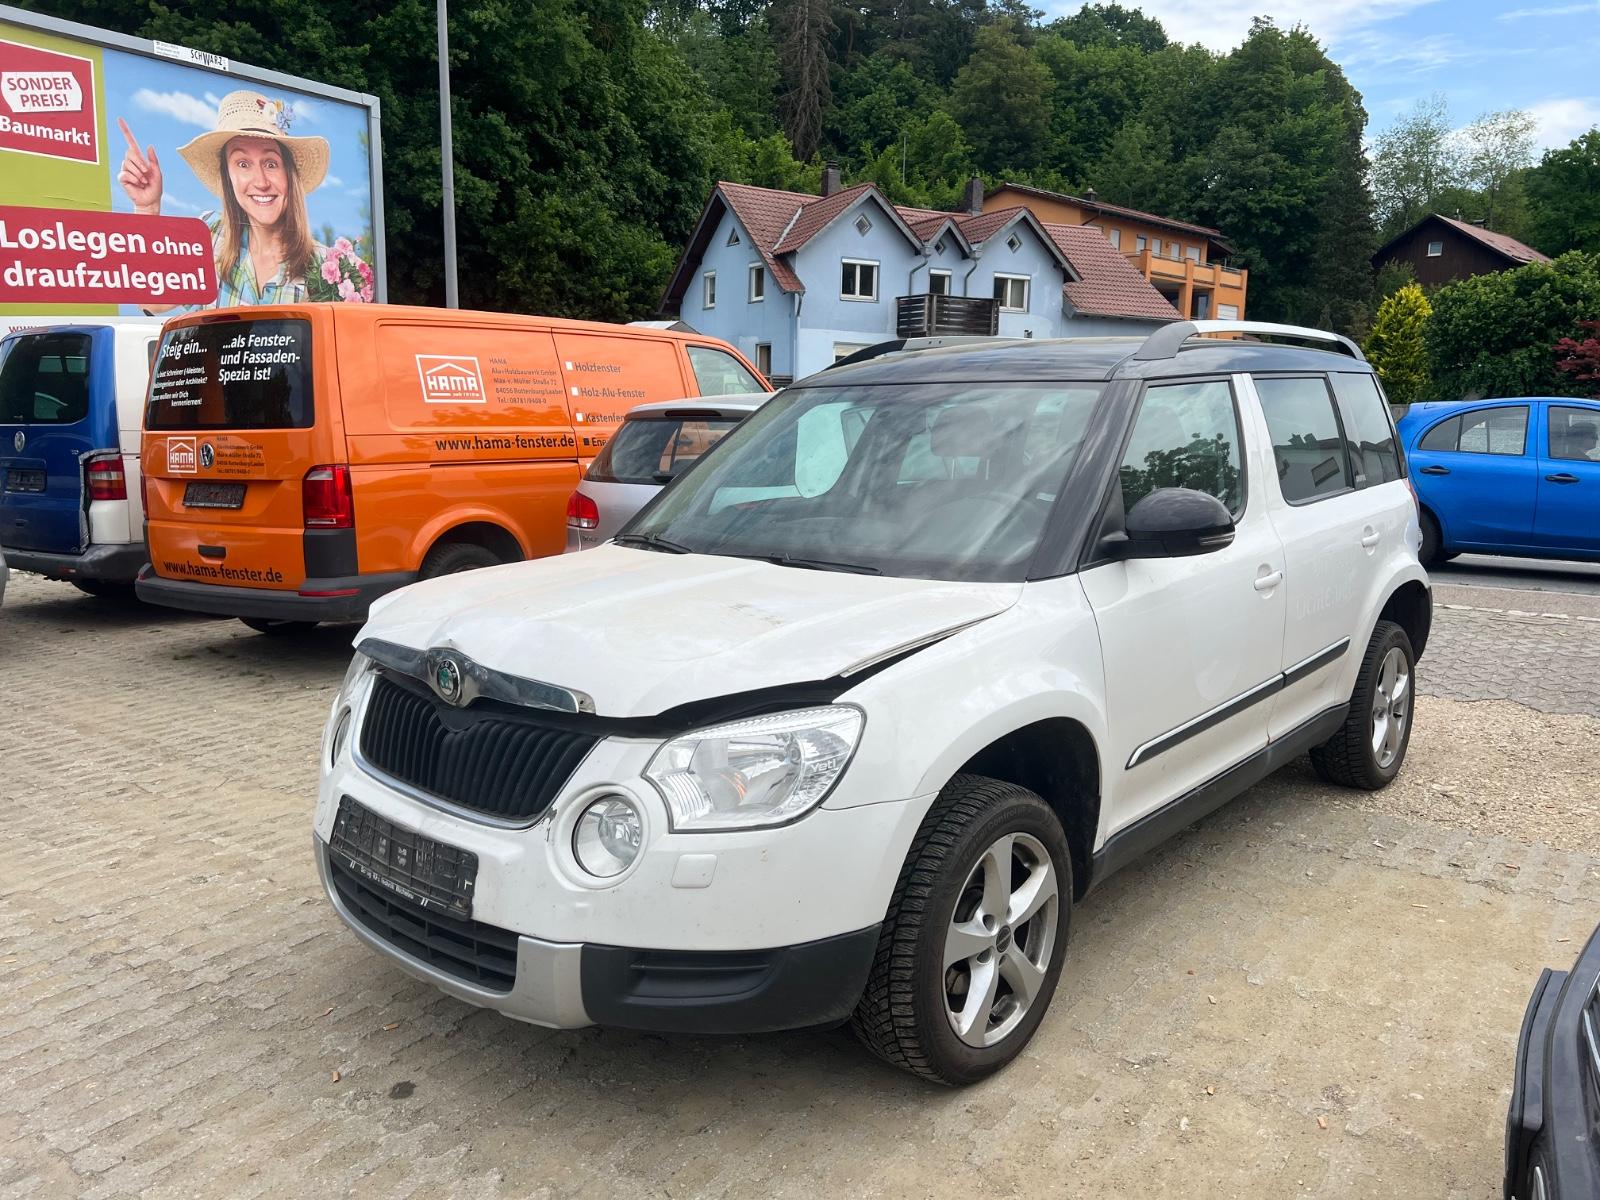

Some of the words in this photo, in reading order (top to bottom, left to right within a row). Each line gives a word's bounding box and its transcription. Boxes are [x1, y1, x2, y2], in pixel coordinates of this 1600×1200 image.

[190, 49, 223, 66] SCHWARZ
[7, 77, 73, 91] SONDER
[20, 93, 69, 107] PREIS!
[0, 115, 91, 146] Baumarkt
[0, 220, 146, 259] Loslegen
[152, 236, 204, 256] ohne
[3, 260, 207, 296] draufzulegen!
[247, 334, 296, 348] Fenster-
[161, 341, 183, 360] Steig
[183, 339, 208, 355] ein...
[220, 350, 241, 365] und
[242, 349, 301, 365] Fassaden-
[575, 362, 621, 373] Holzfenster
[218, 366, 251, 386] Spezia
[253, 366, 271, 380] ist!
[426, 375, 479, 391] HAMA
[580, 387, 646, 398] Holz-Alu-Fenster
[434, 434, 575, 450] www.hama-fenster.de
[169, 452, 194, 464] HAMA
[163, 560, 283, 583] www.hama-fenster.de
